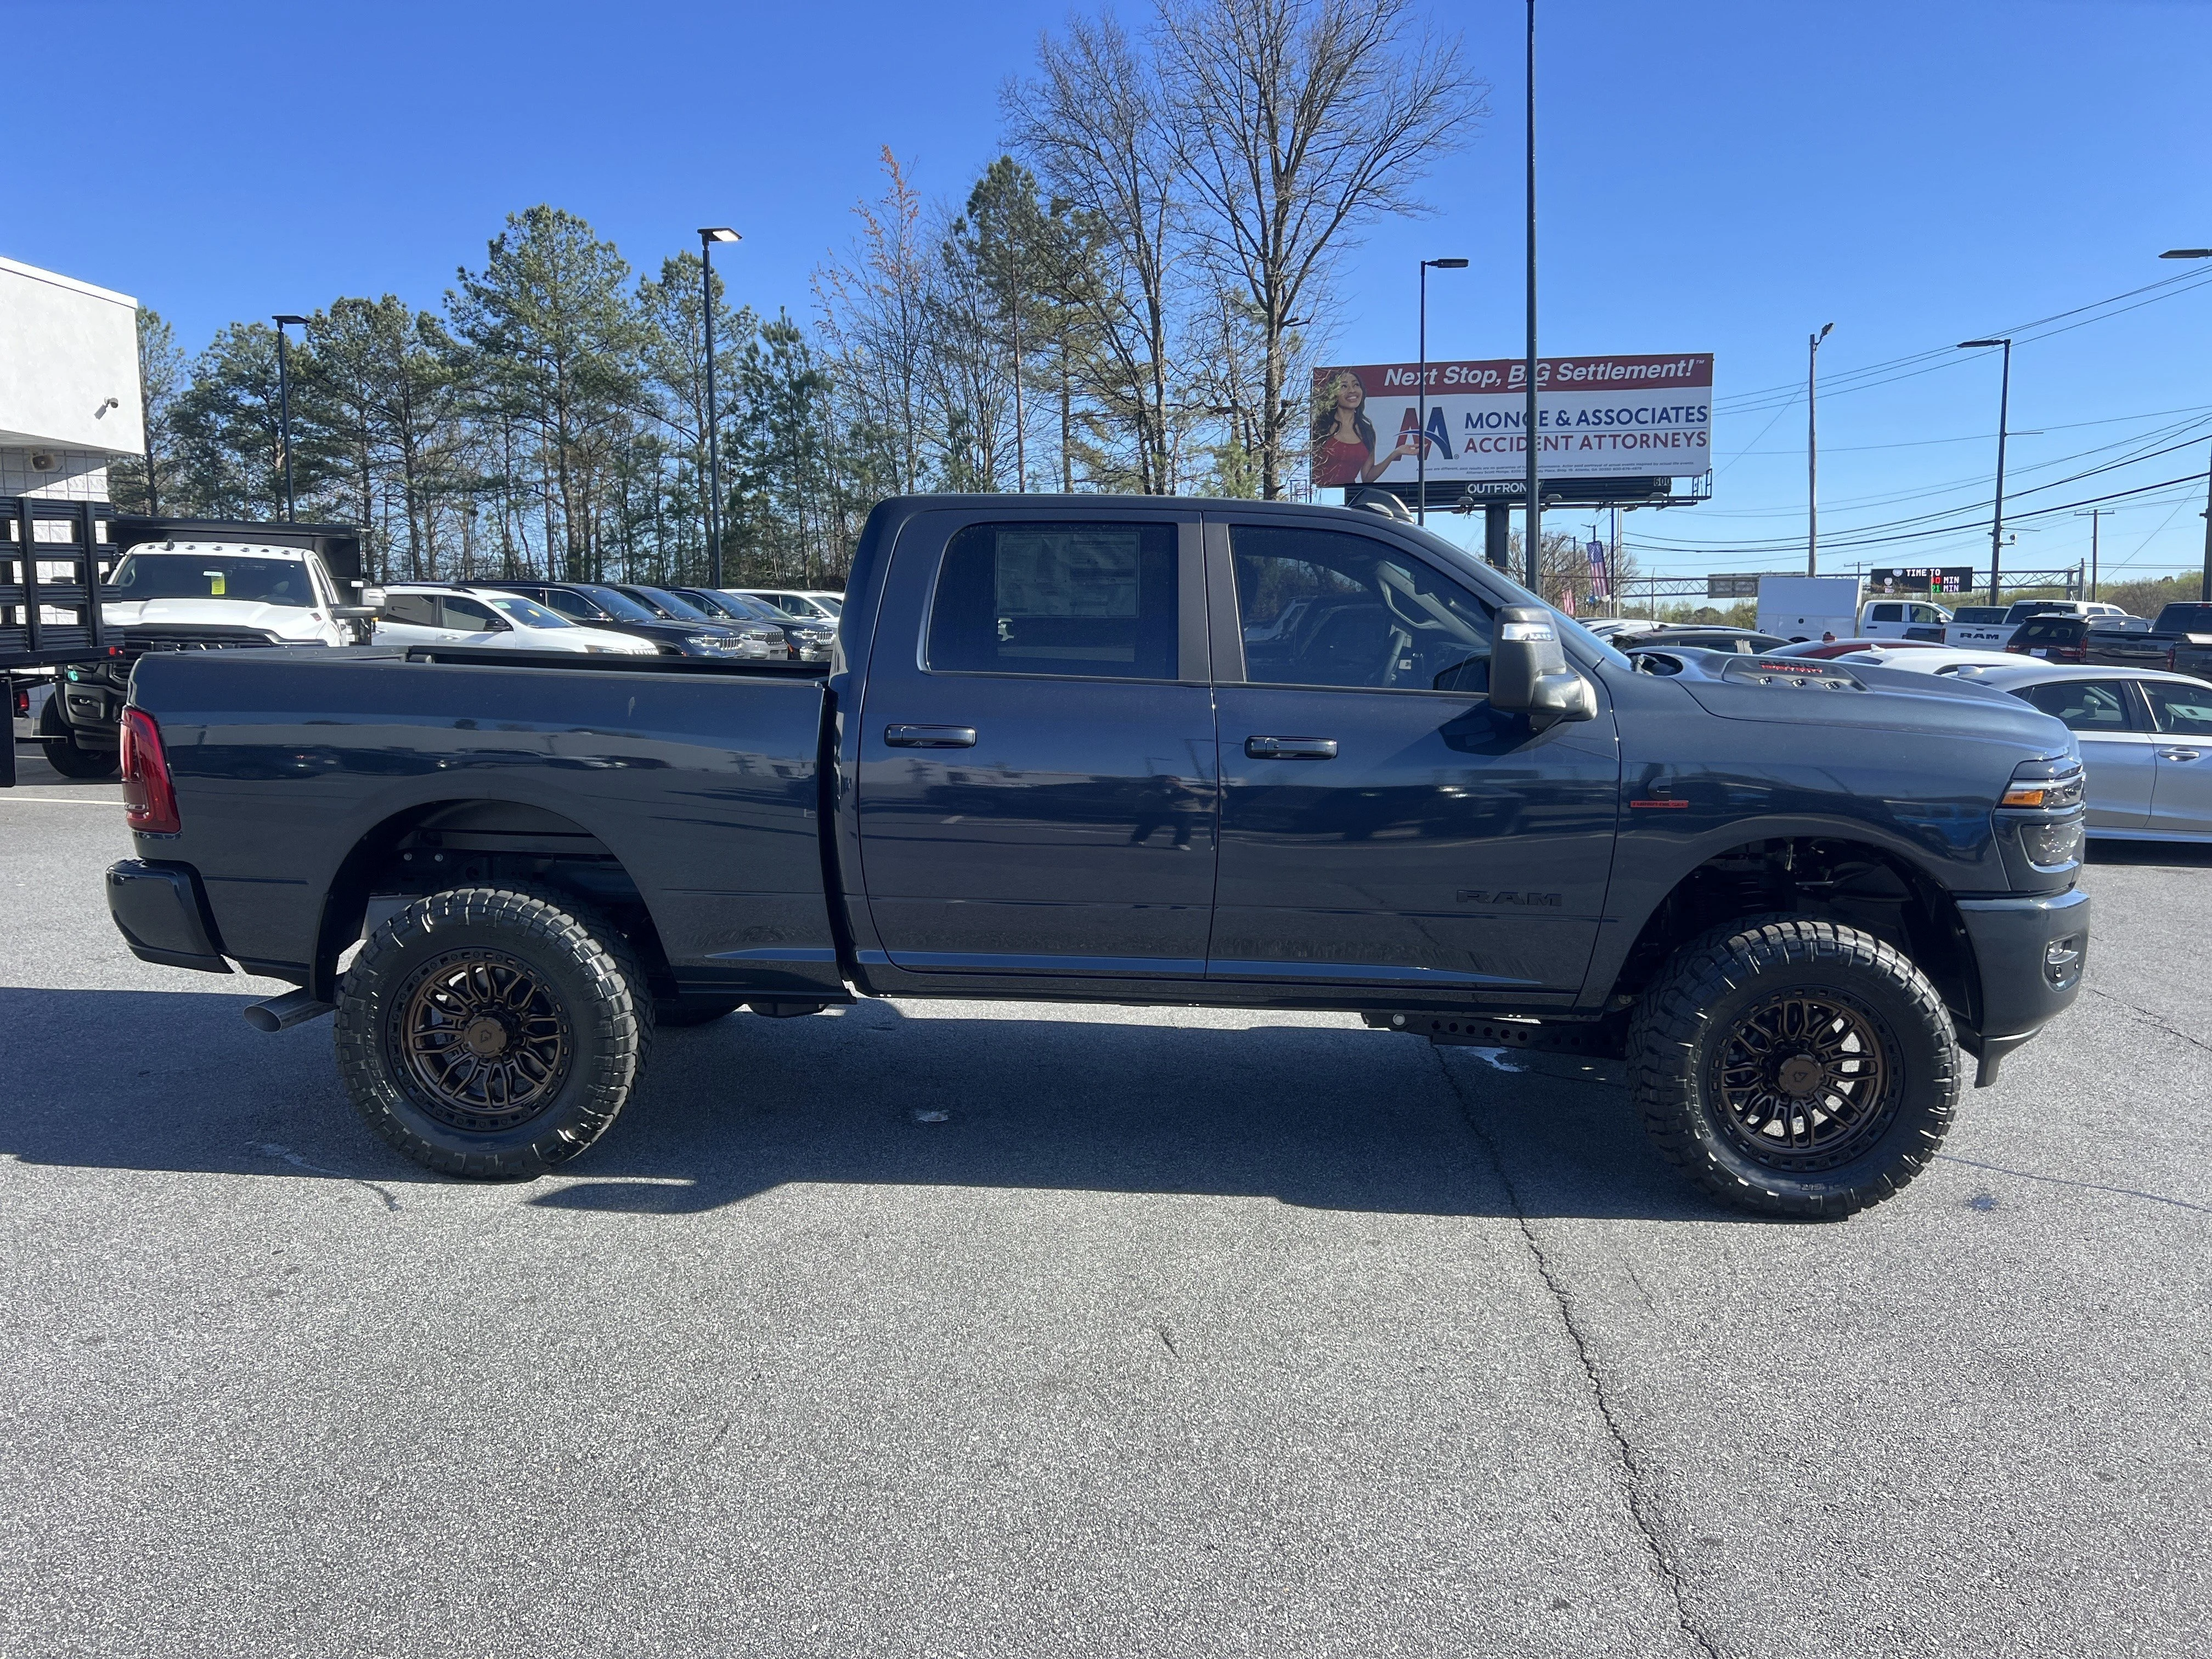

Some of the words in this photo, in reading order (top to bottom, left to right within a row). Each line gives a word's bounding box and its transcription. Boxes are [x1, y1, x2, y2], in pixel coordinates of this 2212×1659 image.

[1384, 368, 1437, 386] Next
[1443, 366, 1502, 388] Stop,
[1508, 363, 1551, 383] BG
[1556, 359, 1695, 381] Settlement!
[1555, 410, 1571, 426] &
[1576, 405, 1707, 426] ASSOCIATES
[1579, 431, 1707, 450] ATTORNEYS
[1467, 482, 1541, 494] OUTFRON
[1906, 568, 1927, 577] TIME
[1929, 568, 1941, 577] TO
[1943, 576, 1960, 584] MIN
[1943, 584, 1960, 592] MIN
[1457, 890, 1563, 906] RAM
